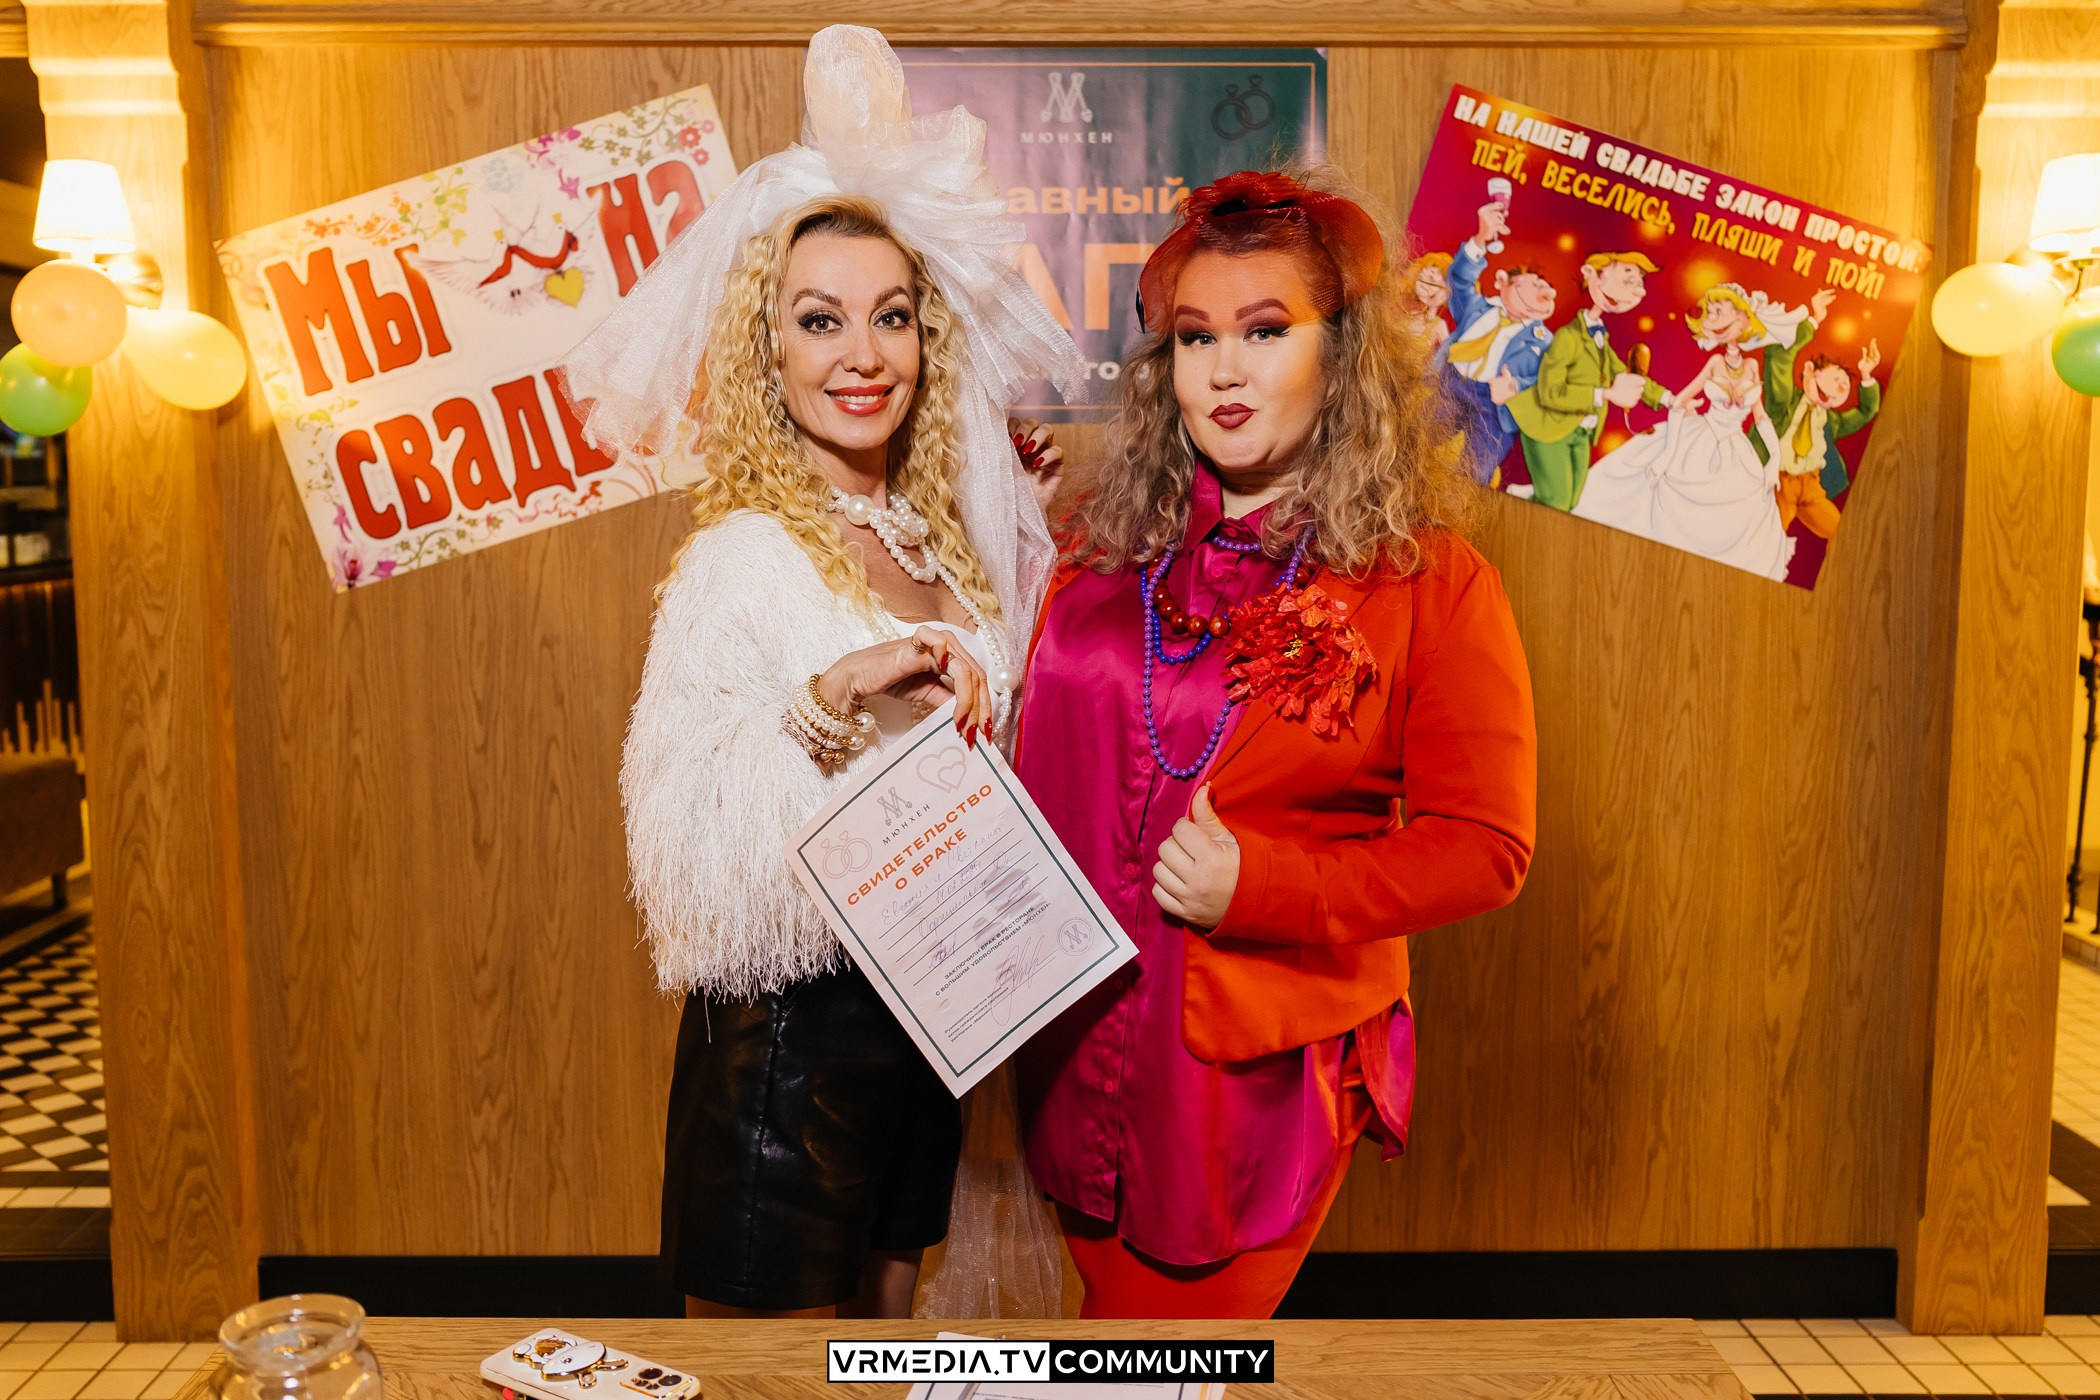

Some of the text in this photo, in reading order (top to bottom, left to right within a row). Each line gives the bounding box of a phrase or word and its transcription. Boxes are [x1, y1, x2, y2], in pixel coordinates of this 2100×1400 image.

[1020, 131, 1114, 144] МЮНХЕН
[1453, 94, 1491, 128] НА
[1496, 109, 1591, 160] НАШЕЙ
[1596, 142, 1711, 202] СВАДЬБЕ
[1715, 183, 1801, 231] ЗАКОН
[1006, 176, 1191, 215] авный
[1471, 138, 1886, 300] ПЕЙ, ВЕСЕЛИСЬ, ПЛЯШИ И ПОЙ!
[336, 366, 635, 541] свадь
[847, 784, 993, 906] СВИДЕТЕЛЬСТВО
[882, 803, 931, 845] МЮНХЕН
[895, 828, 967, 890] О БРАКЕ
[940, 966, 971, 992] БОЛЬШИМ
[970, 926, 1022, 967] УДОВОЛЬСТВИЕМ
[944, 948, 982, 979] ЗАКЛЮЧИЛИ
[980, 936, 997, 950] БРАК
[1001, 906, 1035, 934] РЕСТОРАНЕ
